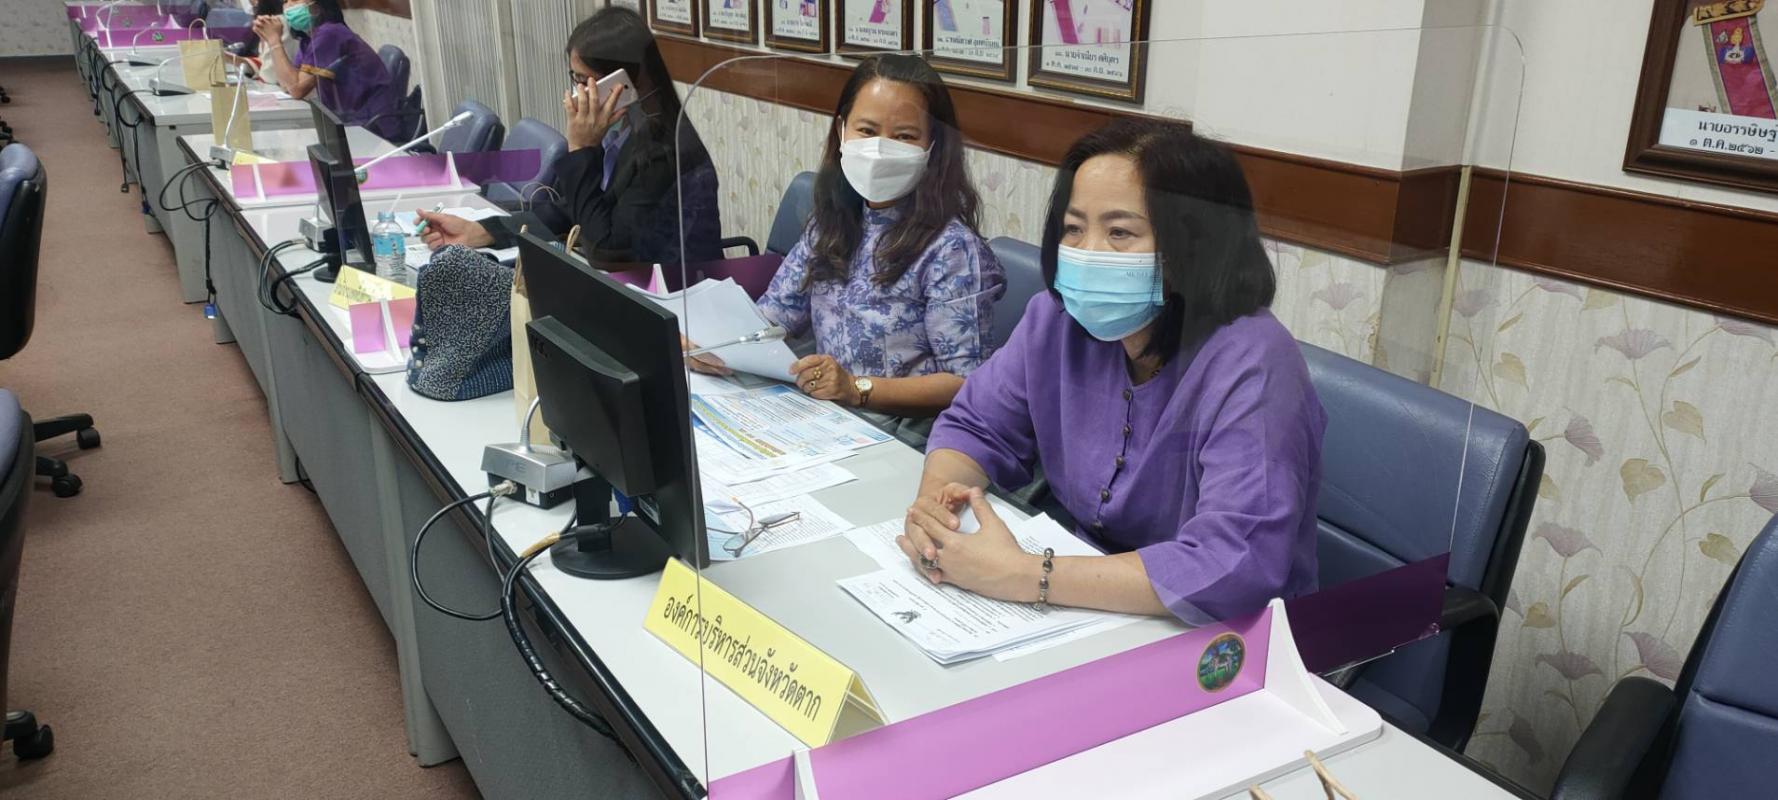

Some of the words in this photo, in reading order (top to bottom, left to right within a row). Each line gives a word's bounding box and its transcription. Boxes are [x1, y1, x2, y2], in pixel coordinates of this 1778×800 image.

[1698, 120, 1778, 142] นายอรรษิษฐ
[663, 594, 822, 722] องค์การบริหารส่วนจังหวัดตาก
